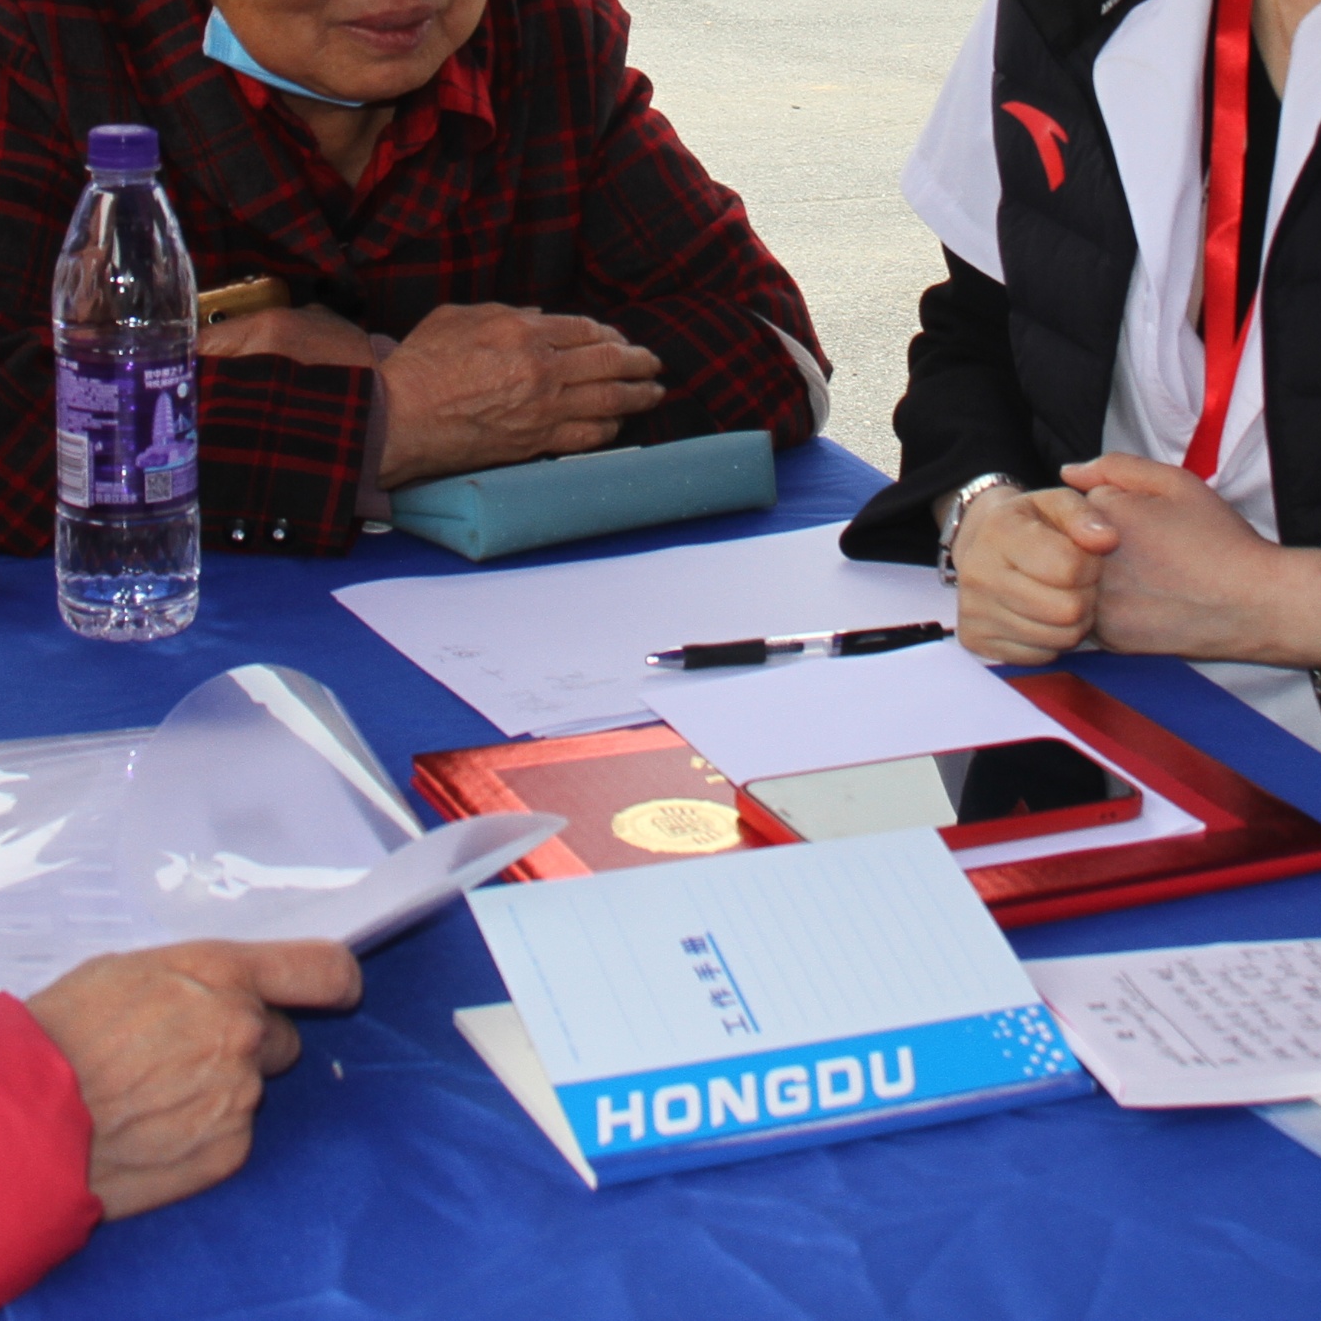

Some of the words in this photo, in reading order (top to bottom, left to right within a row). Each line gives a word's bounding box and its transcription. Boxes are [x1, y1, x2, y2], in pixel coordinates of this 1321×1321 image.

[679, 936, 750, 1036] 工作手册
[596, 1045, 916, 1147] HONGDU
